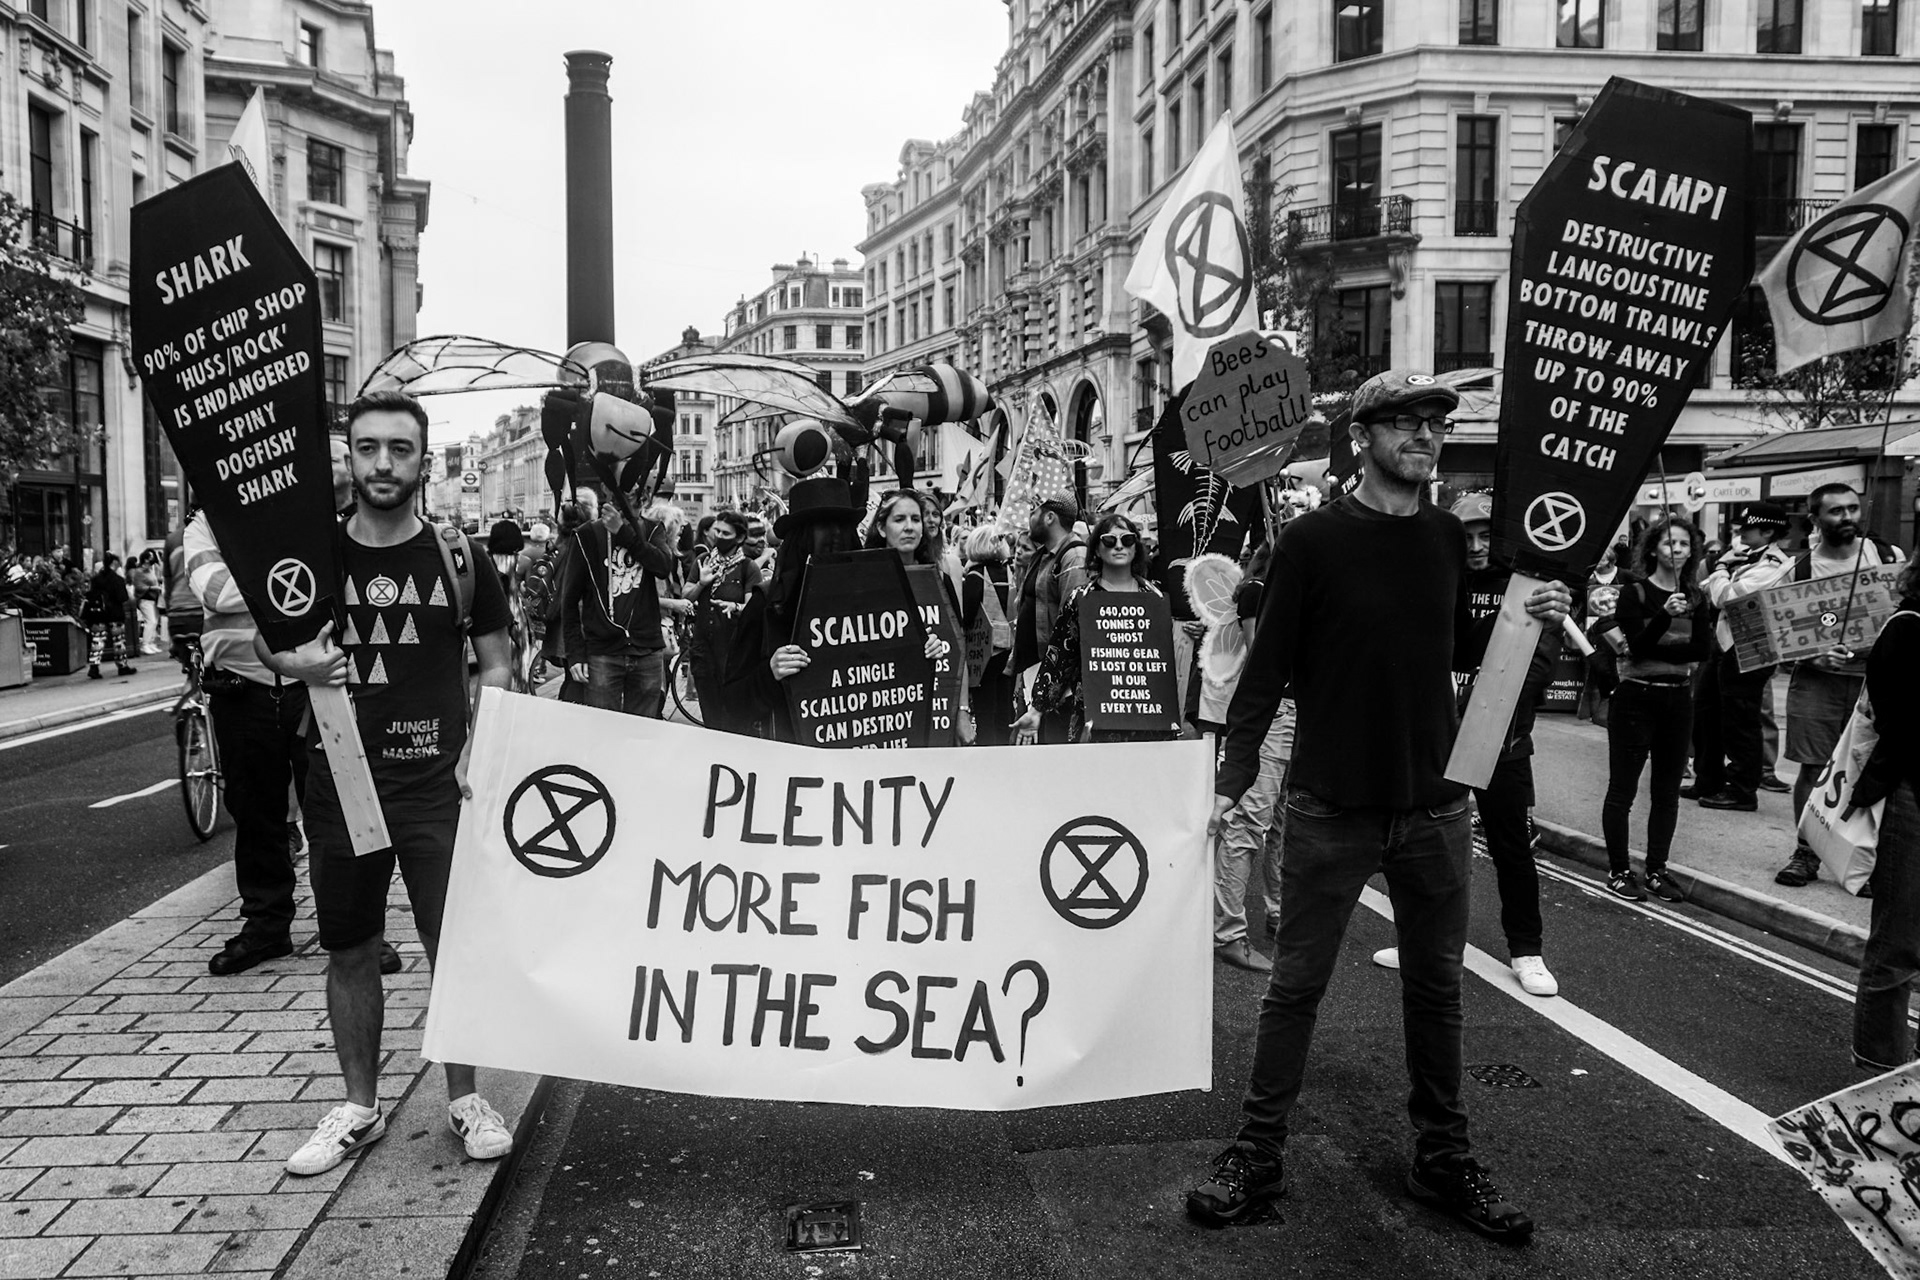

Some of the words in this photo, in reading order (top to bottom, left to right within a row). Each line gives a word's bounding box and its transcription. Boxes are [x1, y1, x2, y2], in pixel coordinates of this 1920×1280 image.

[1588, 156, 1727, 220] SCAMPI
[1562, 219, 1714, 278] DESTRUCTIVE
[156, 234, 251, 304] SHARK
[1546, 250, 1710, 311] LANGOUSTINE
[144, 342, 181, 375] 90%
[184, 327, 206, 354] OF
[212, 308, 249, 341] CHIP
[255, 283, 306, 320] SHOP
[1520, 279, 1617, 323] BOTTOM
[1626, 306, 1717, 348] TRAWLS
[1212, 340, 1268, 377] Bees
[174, 404, 191, 428] IS
[195, 350, 311, 420] ENDANGERED
[1187, 394, 1228, 422] can
[1239, 369, 1290, 414] play
[1535, 357, 1566, 383] UP
[1574, 366, 1605, 393] TO
[1612, 376, 1657, 408] 90%
[1204, 394, 1309, 466] football!
[1550, 397, 1581, 422] OF
[1588, 405, 1629, 435] THE
[1541, 433, 1616, 471] CATCH
[237, 462, 298, 505] SHARK
[1341, 473, 1358, 495] THE
[1713, 487, 1733, 498] CARTE
[1776, 476, 1802, 487] Frozen
[1802, 473, 1827, 484] Yogurt
[1471, 592, 1491, 605] THE
[1792, 576, 1853, 600] TAKES
[1806, 590, 1878, 615] CREATE
[1096, 619, 1135, 630] TONNES
[1137, 619, 1150, 629] OF
[1100, 606, 1145, 617] 640,000
[810, 610, 908, 647] SCALLOP
[1089, 660, 1098, 671] IS
[1101, 661, 1126, 671] LOST
[1129, 662, 1144, 672] OR
[1146, 662, 1167, 672] LEFT
[1091, 647, 1130, 658] FISHING
[1133, 648, 1160, 659] GEAR
[832, 669, 842, 688] A
[847, 662, 895, 685] SINGLE
[1112, 675, 1123, 685] IN
[1126, 675, 1147, 686] OUR
[801, 692, 867, 718] SCALLOP
[872, 683, 923, 708] DREDGE
[1101, 703, 1132, 713] EVERY
[1135, 703, 1162, 714] YEAR
[1110, 689, 1151, 700] OCEANS
[386, 718, 440, 734] JUNGLE
[411, 731, 439, 747] WAS
[815, 721, 847, 743] CAN
[852, 711, 913, 738] DESTROY
[382, 744, 440, 760] MASSIVE
[703, 764, 955, 848] PLENTY
[1808, 800, 1831, 832] NDON
[647, 858, 820, 936] MORE
[847, 874, 975, 944] FISH
[628, 965, 699, 1043] IN
[711, 964, 837, 1051] THE
[854, 960, 1049, 1087] SEA?
